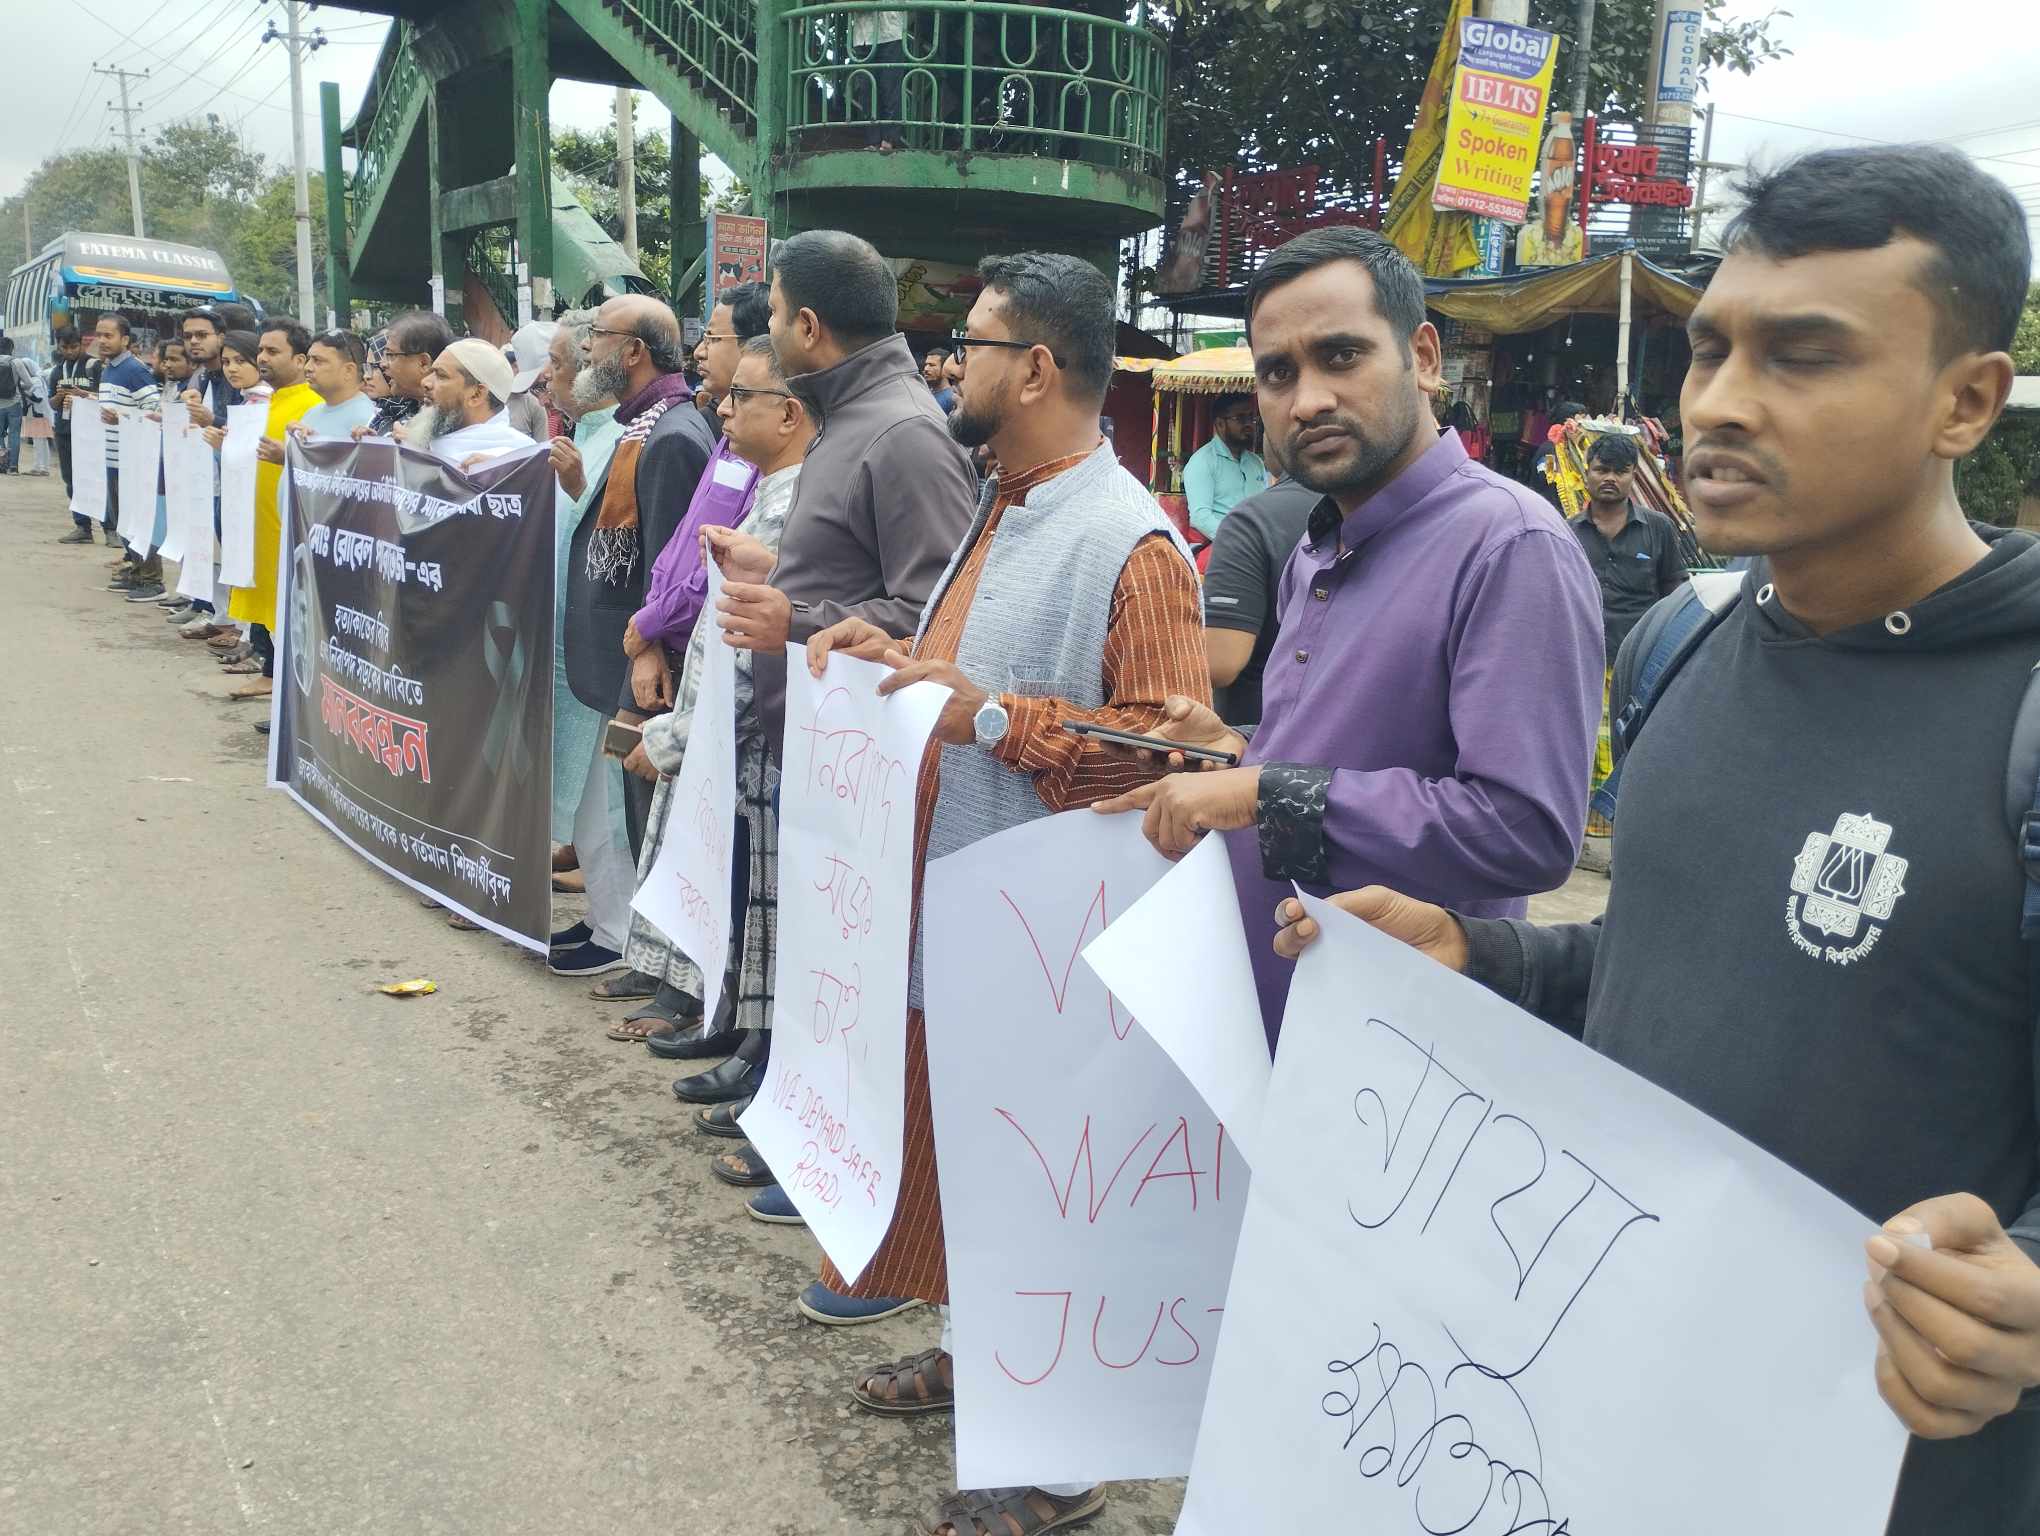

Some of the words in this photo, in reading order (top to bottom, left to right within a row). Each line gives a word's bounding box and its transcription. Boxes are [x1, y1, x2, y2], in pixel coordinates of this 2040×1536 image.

[1466, 22, 1550, 60] Global
[1680, 25, 1697, 86] GLOBAL
[1465, 76, 1539, 113] IELTS
[1458, 128, 1528, 162] Spoken
[1455, 157, 1523, 193] Writing
[79, 242, 149, 261] FATEMA
[152, 249, 219, 272] CLASSIC
[485, 493, 522, 519] ছাত্র
[382, 663, 424, 706] দাবিতে
[319, 672, 431, 784] মানববন্ধন
[400, 831, 409, 854] ও
[409, 832, 450, 874] বর্তমান
[450, 843, 513, 906] শিক্ষার্থীবৃন্দ
[842, 1144, 881, 1207] SAFE
[995, 1291, 1225, 1386] JUS
